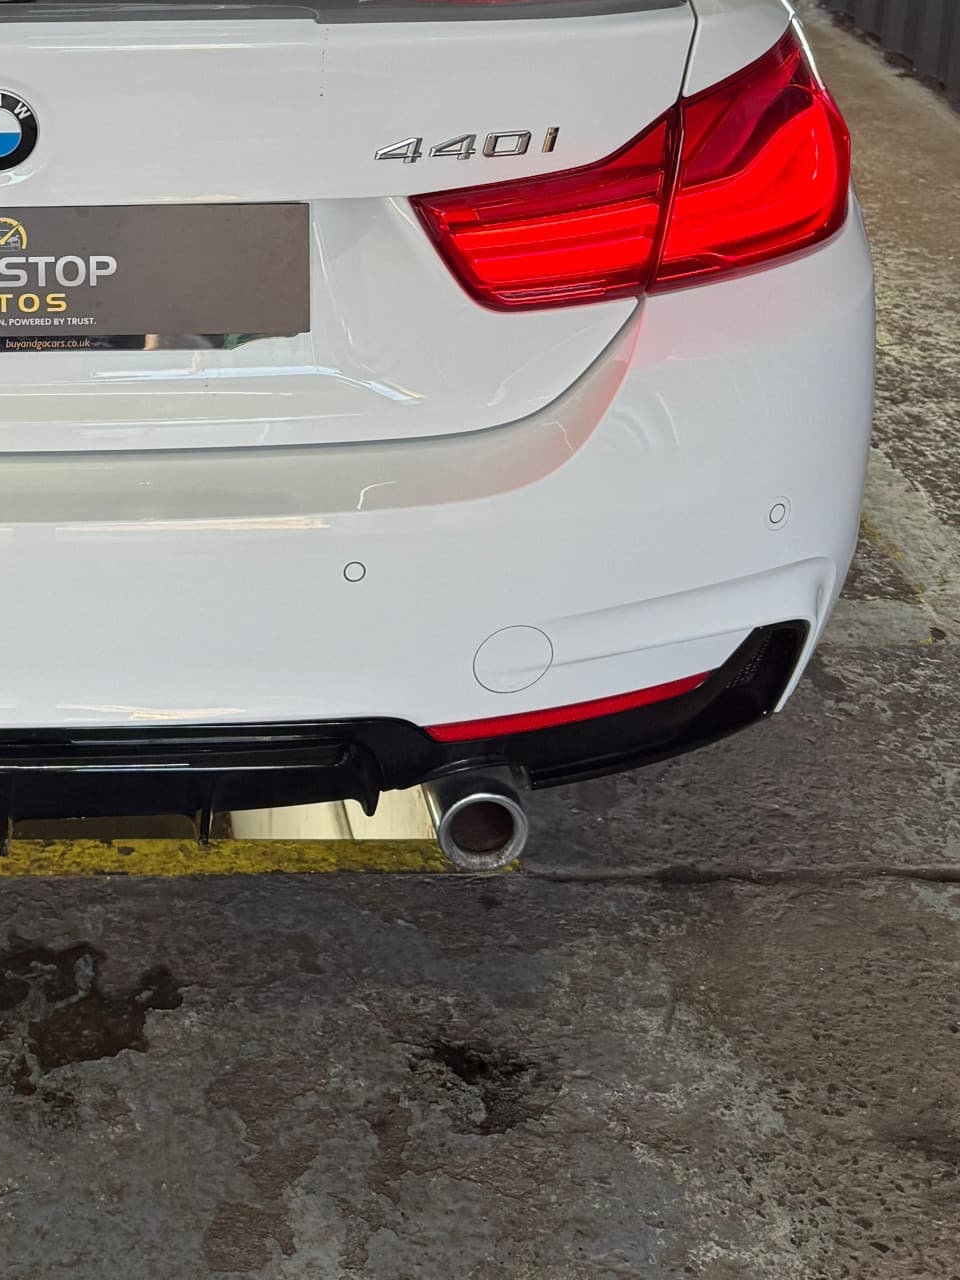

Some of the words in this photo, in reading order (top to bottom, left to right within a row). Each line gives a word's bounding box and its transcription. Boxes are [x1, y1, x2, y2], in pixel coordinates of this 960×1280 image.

[374, 127, 560, 163] 440i
[9, 318, 52, 326] POWERED
[53, 318, 65, 326] BY
[67, 317, 97, 326] TRUST.
[5, 337, 90, 350] buyandgocars.co.uk
